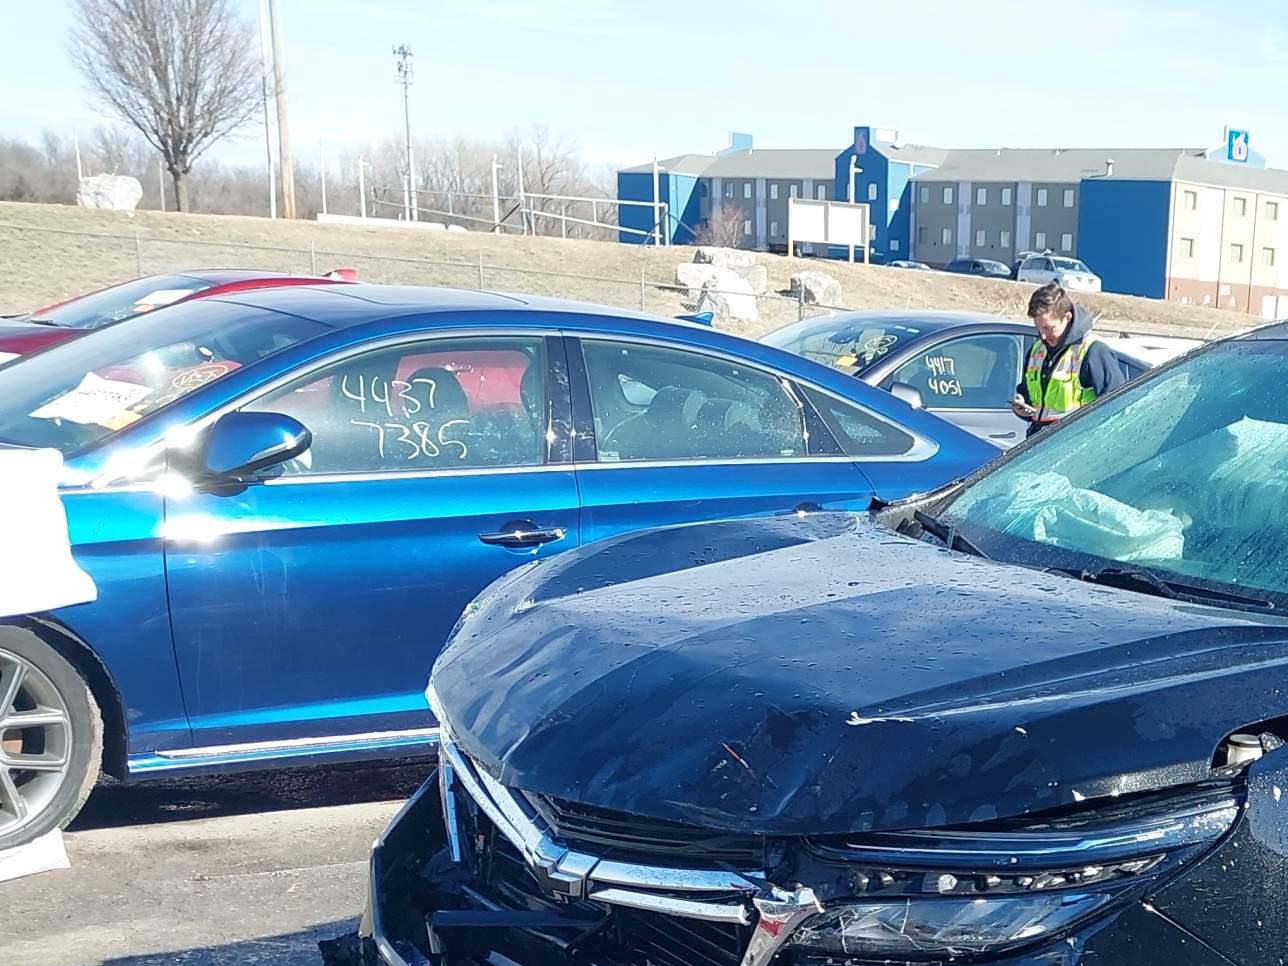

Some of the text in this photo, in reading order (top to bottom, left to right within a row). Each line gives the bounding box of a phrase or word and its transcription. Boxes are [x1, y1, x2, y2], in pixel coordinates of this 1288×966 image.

[925, 355, 955, 377] 4417
[341, 375, 436, 417] 4437
[928, 378, 962, 396] 4051
[350, 418, 470, 460] 7385
